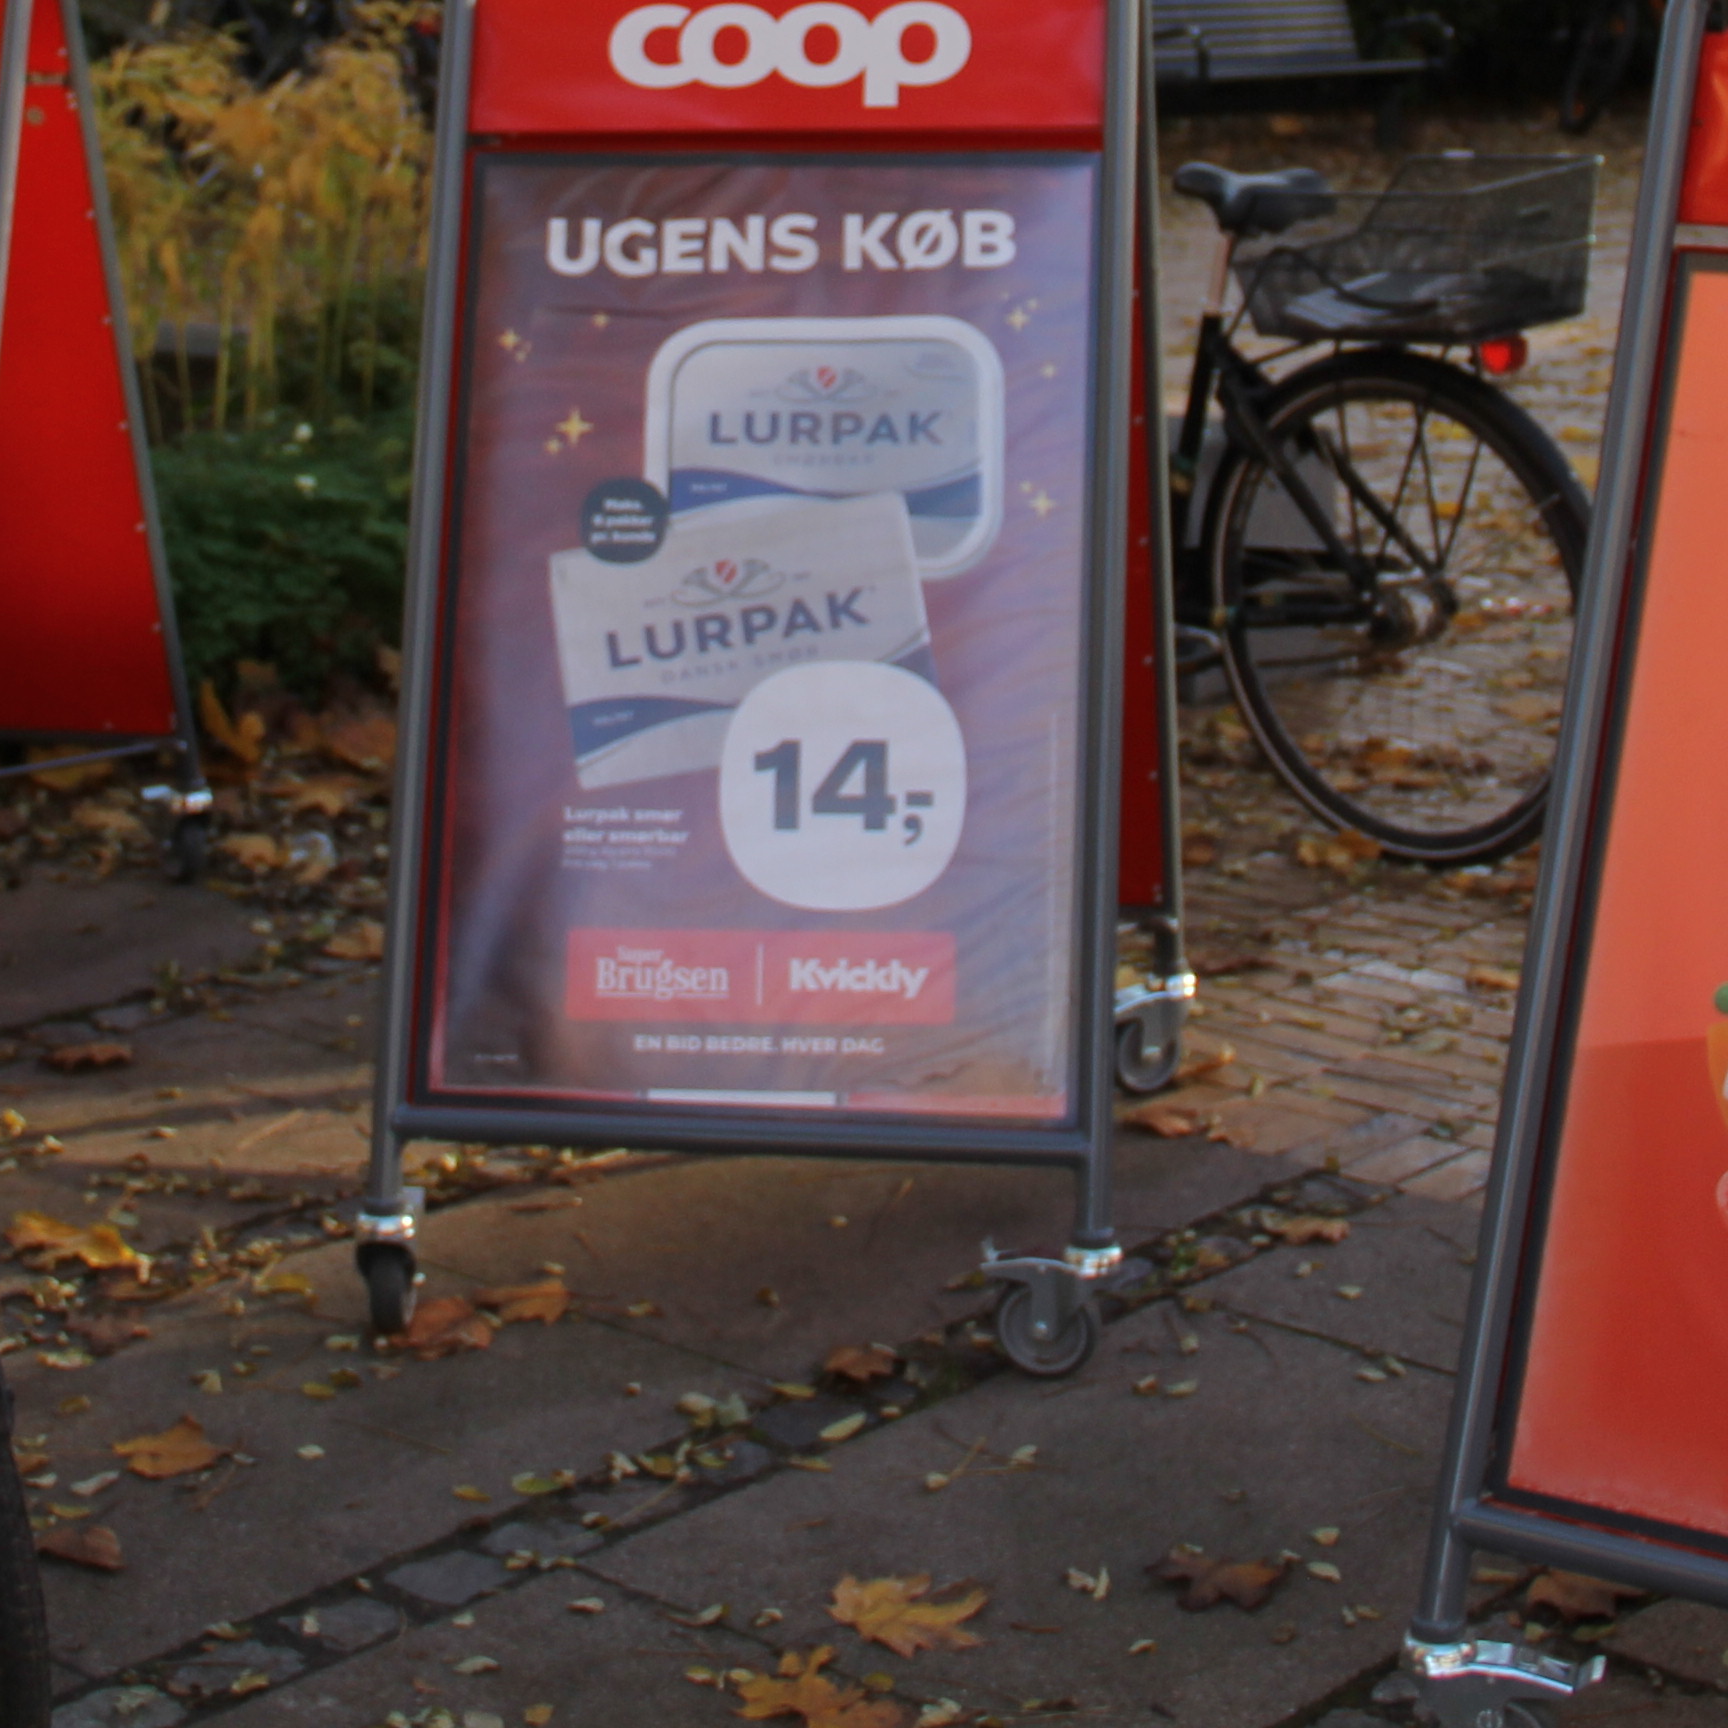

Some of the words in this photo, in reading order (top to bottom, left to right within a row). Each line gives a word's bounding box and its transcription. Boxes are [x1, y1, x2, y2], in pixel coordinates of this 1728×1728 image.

[607, 0, 972, 108] coop
[545, 211, 820, 277] UGENS
[842, 208, 1017, 272] KØB
[708, 411, 945, 447] LURPAK
[605, 585, 871, 668] LURPAK
[563, 807, 629, 825] Lurpak
[617, 946, 663, 966] Super
[595, 956, 730, 1000] Brugsen
[788, 958, 929, 1000] Kvickly
[634, 1035, 664, 1052] EN
[666, 1035, 702, 1053] BID
[782, 1037, 836, 1054] HVER
[840, 1037, 884, 1055] DAG
